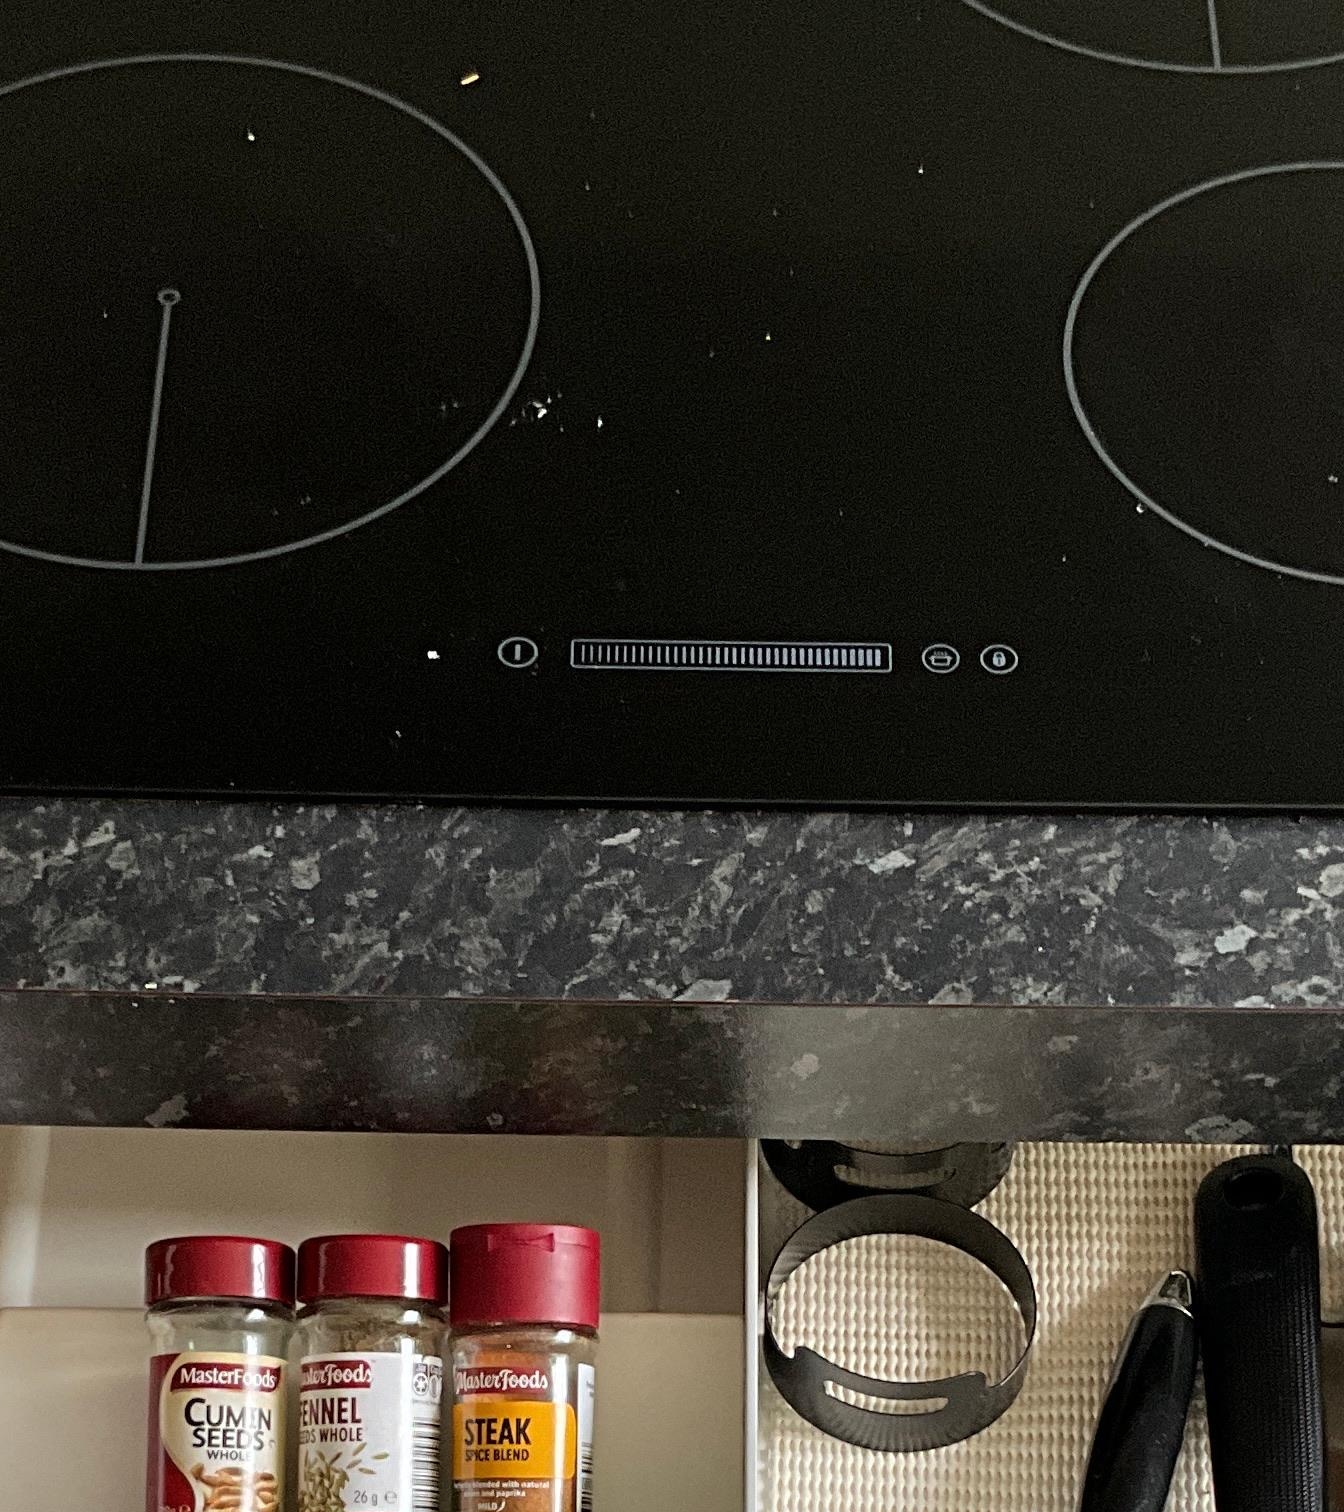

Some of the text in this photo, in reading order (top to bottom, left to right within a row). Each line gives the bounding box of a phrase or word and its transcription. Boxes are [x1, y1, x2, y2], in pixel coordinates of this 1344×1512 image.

[180, 1367, 276, 1388] MasterFoods
[456, 1369, 548, 1394] MasterFoods
[192, 1428, 264, 1451] SEEDS
[319, 1427, 363, 1443] WHOLE
[464, 1417, 532, 1446] STEAK
[207, 1449, 252, 1462] WHOLE
[465, 1448, 530, 1462] SPICE BLEND
[353, 1490, 378, 1507] 26 g
